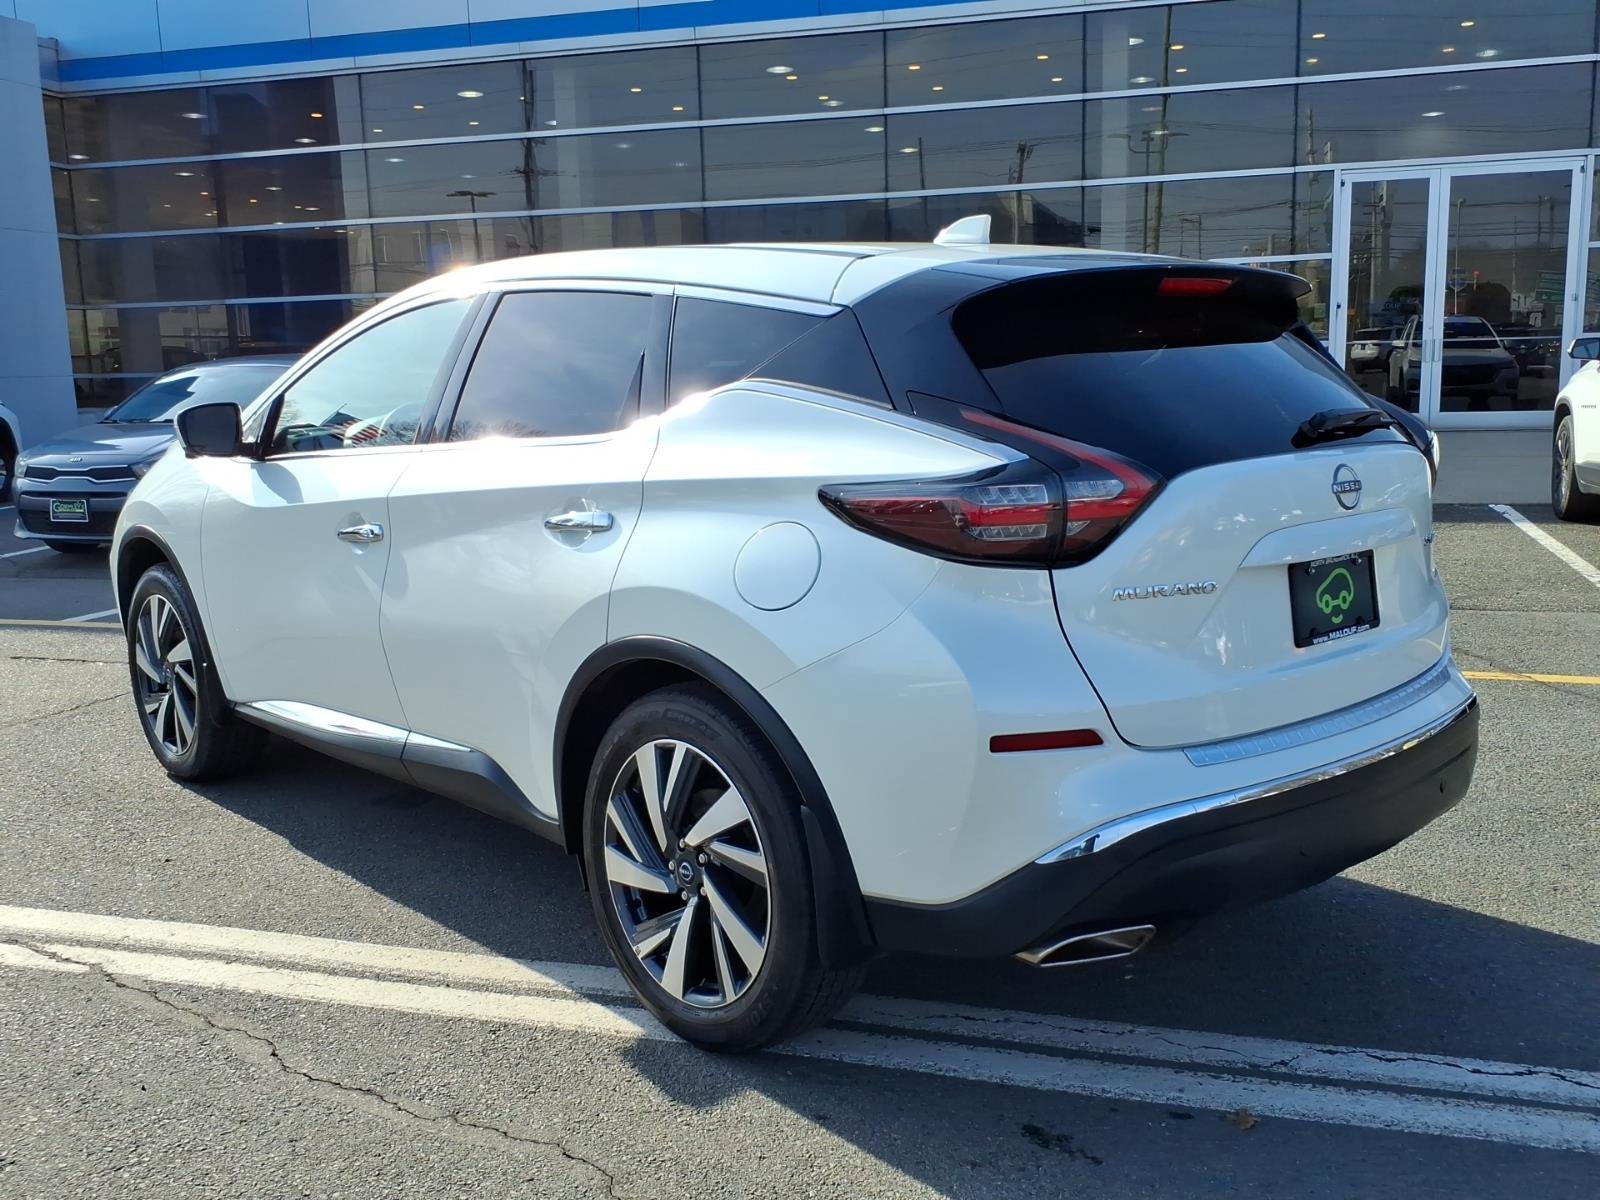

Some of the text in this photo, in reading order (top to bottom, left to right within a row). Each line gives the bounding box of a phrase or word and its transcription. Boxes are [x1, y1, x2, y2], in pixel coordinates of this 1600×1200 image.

[1332, 480, 1361, 493] NISS
[1112, 579, 1218, 602] MURANO
[1312, 624, 1370, 645] www.MALOUF.com
